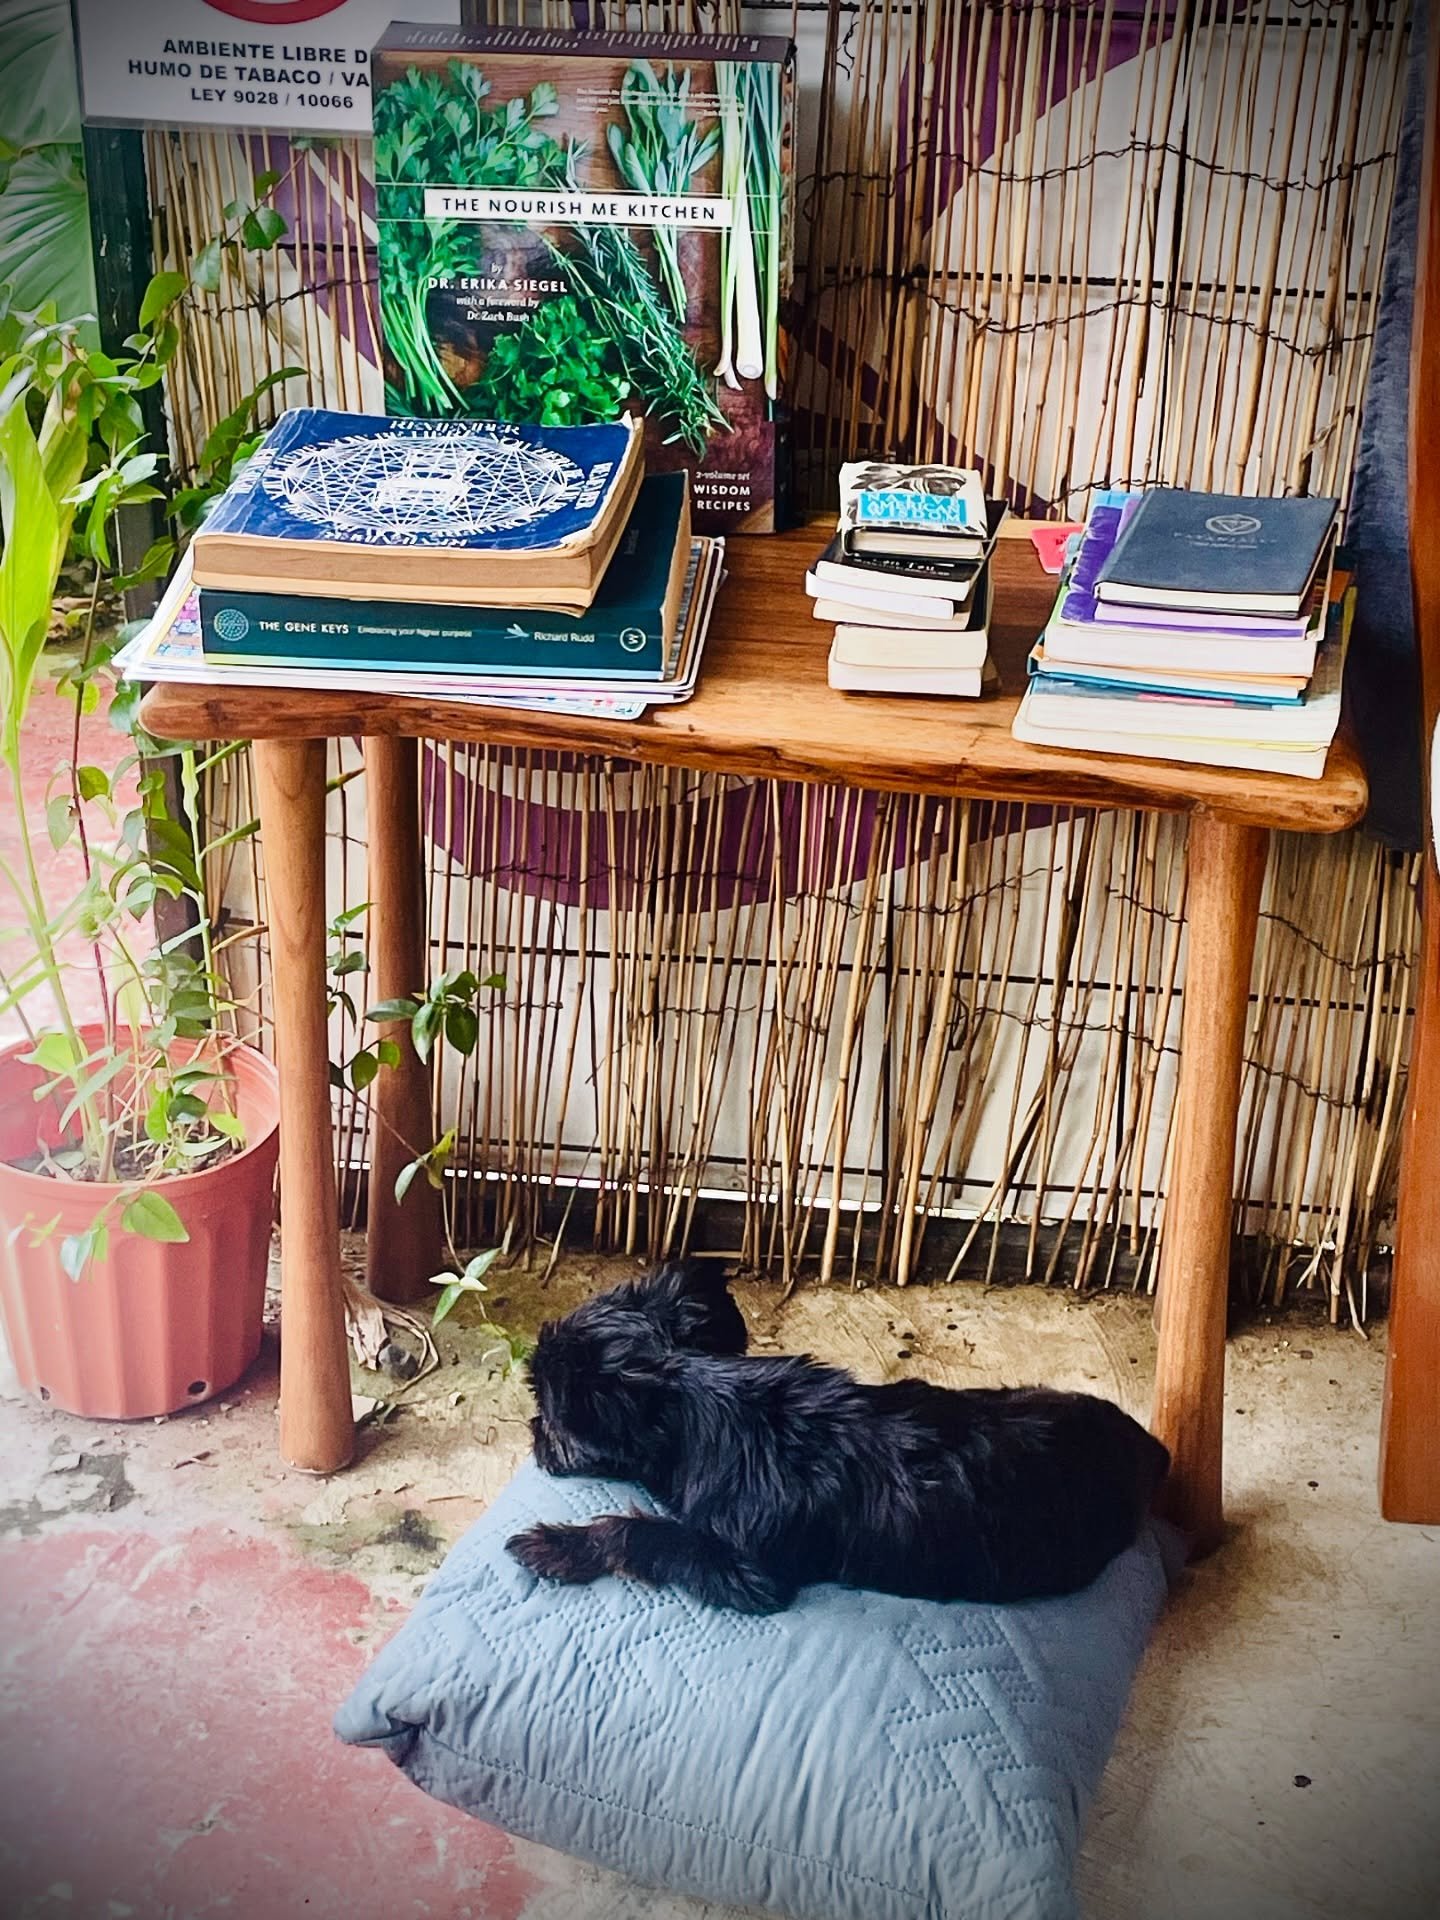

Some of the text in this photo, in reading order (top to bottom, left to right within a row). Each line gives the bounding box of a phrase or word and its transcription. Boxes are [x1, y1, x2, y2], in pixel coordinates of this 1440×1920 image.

[163, 39, 275, 60] AMBIENTE
[283, 46, 347, 64] LIBRE
[128, 60, 192, 78] HUMO
[200, 64, 228, 80] DE
[236, 67, 321, 86] TABACO
[191, 88, 226, 103] LEY
[234, 90, 279, 106] 9028
[297, 93, 354, 109] 10066
[442, 198, 716, 220] THE NOURISH ME KITCHEN
[491, 262, 503, 275] by
[428, 277, 568, 293] DR. ERIKA SIEGEL
[456, 296, 478, 306] with
[528, 297, 539, 309] by
[693, 484, 751, 496] WISDOM
[697, 500, 751, 511] RECIPES
[258, 621, 280, 632] THE
[284, 622, 317, 633] GENE
[321, 623, 349, 634] KEYS
[533, 631, 595, 643] Richard Rudd
